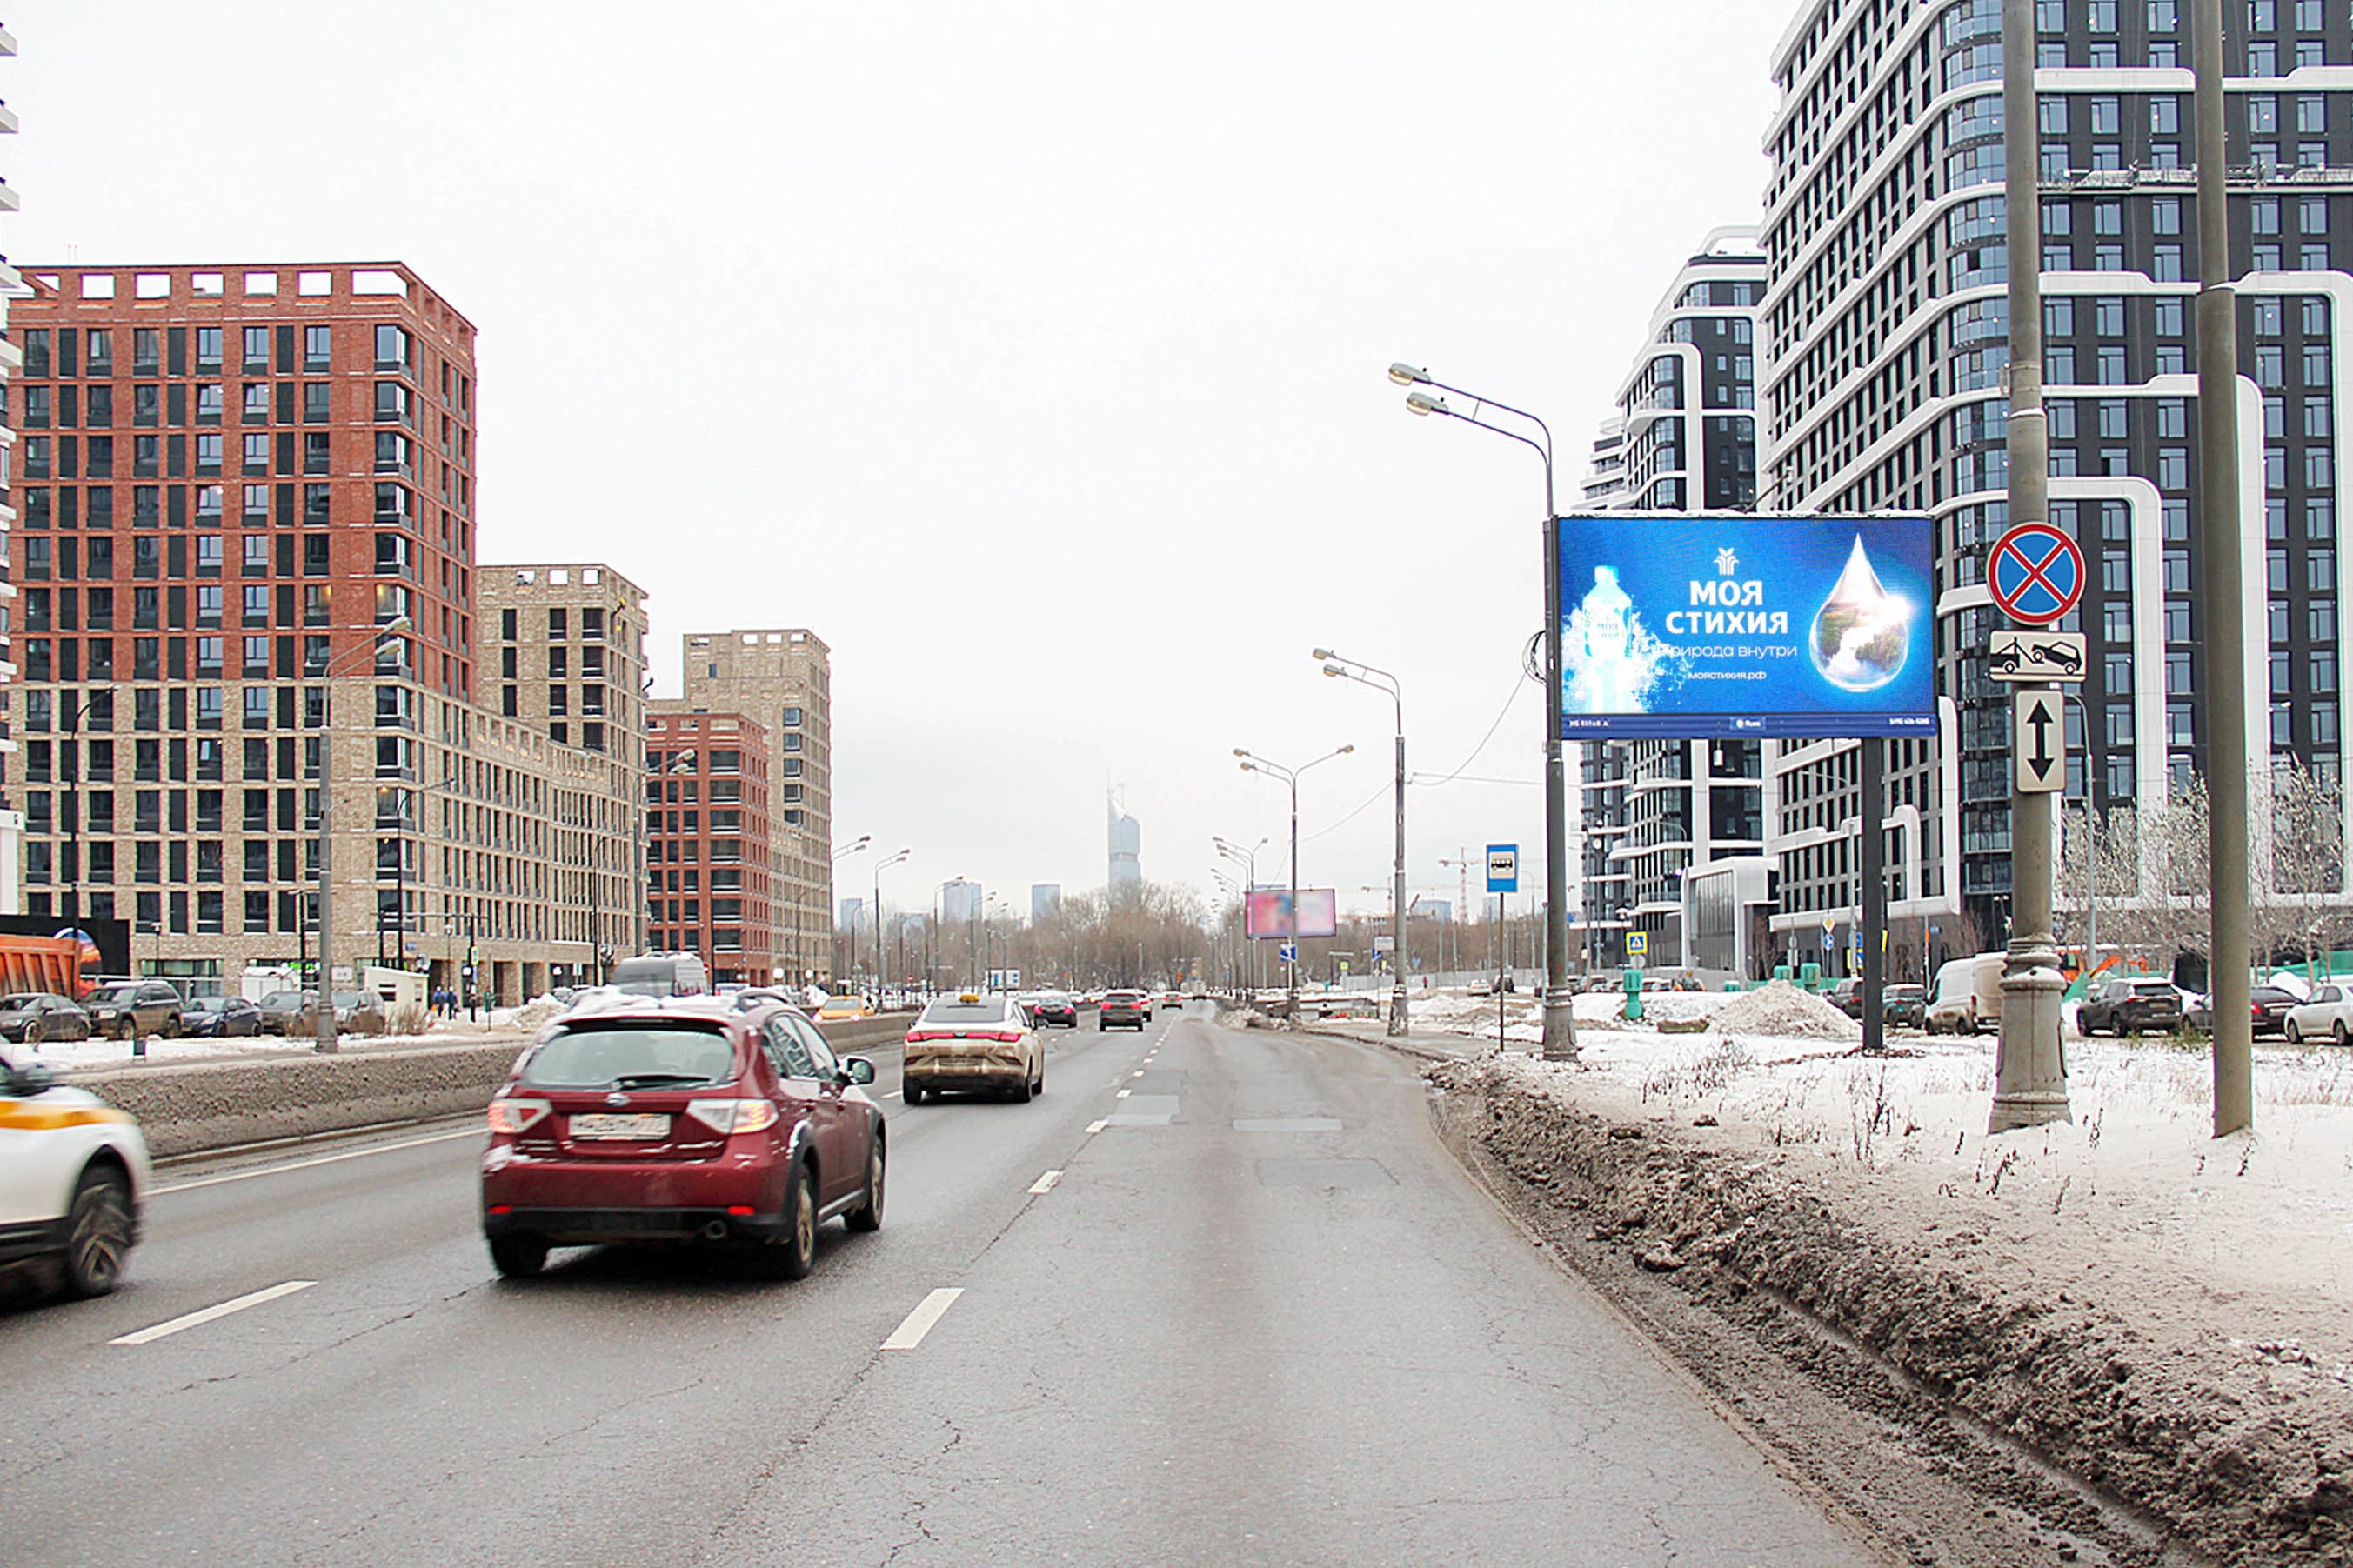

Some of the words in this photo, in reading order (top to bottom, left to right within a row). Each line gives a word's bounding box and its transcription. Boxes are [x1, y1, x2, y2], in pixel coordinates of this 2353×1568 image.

[1690, 580, 1763, 606] МОЯ
[1665, 611, 1788, 634] СТИХИЯ
[1738, 644, 1797, 659] внутри
[1688, 670, 1767, 680] моястихия.рф
